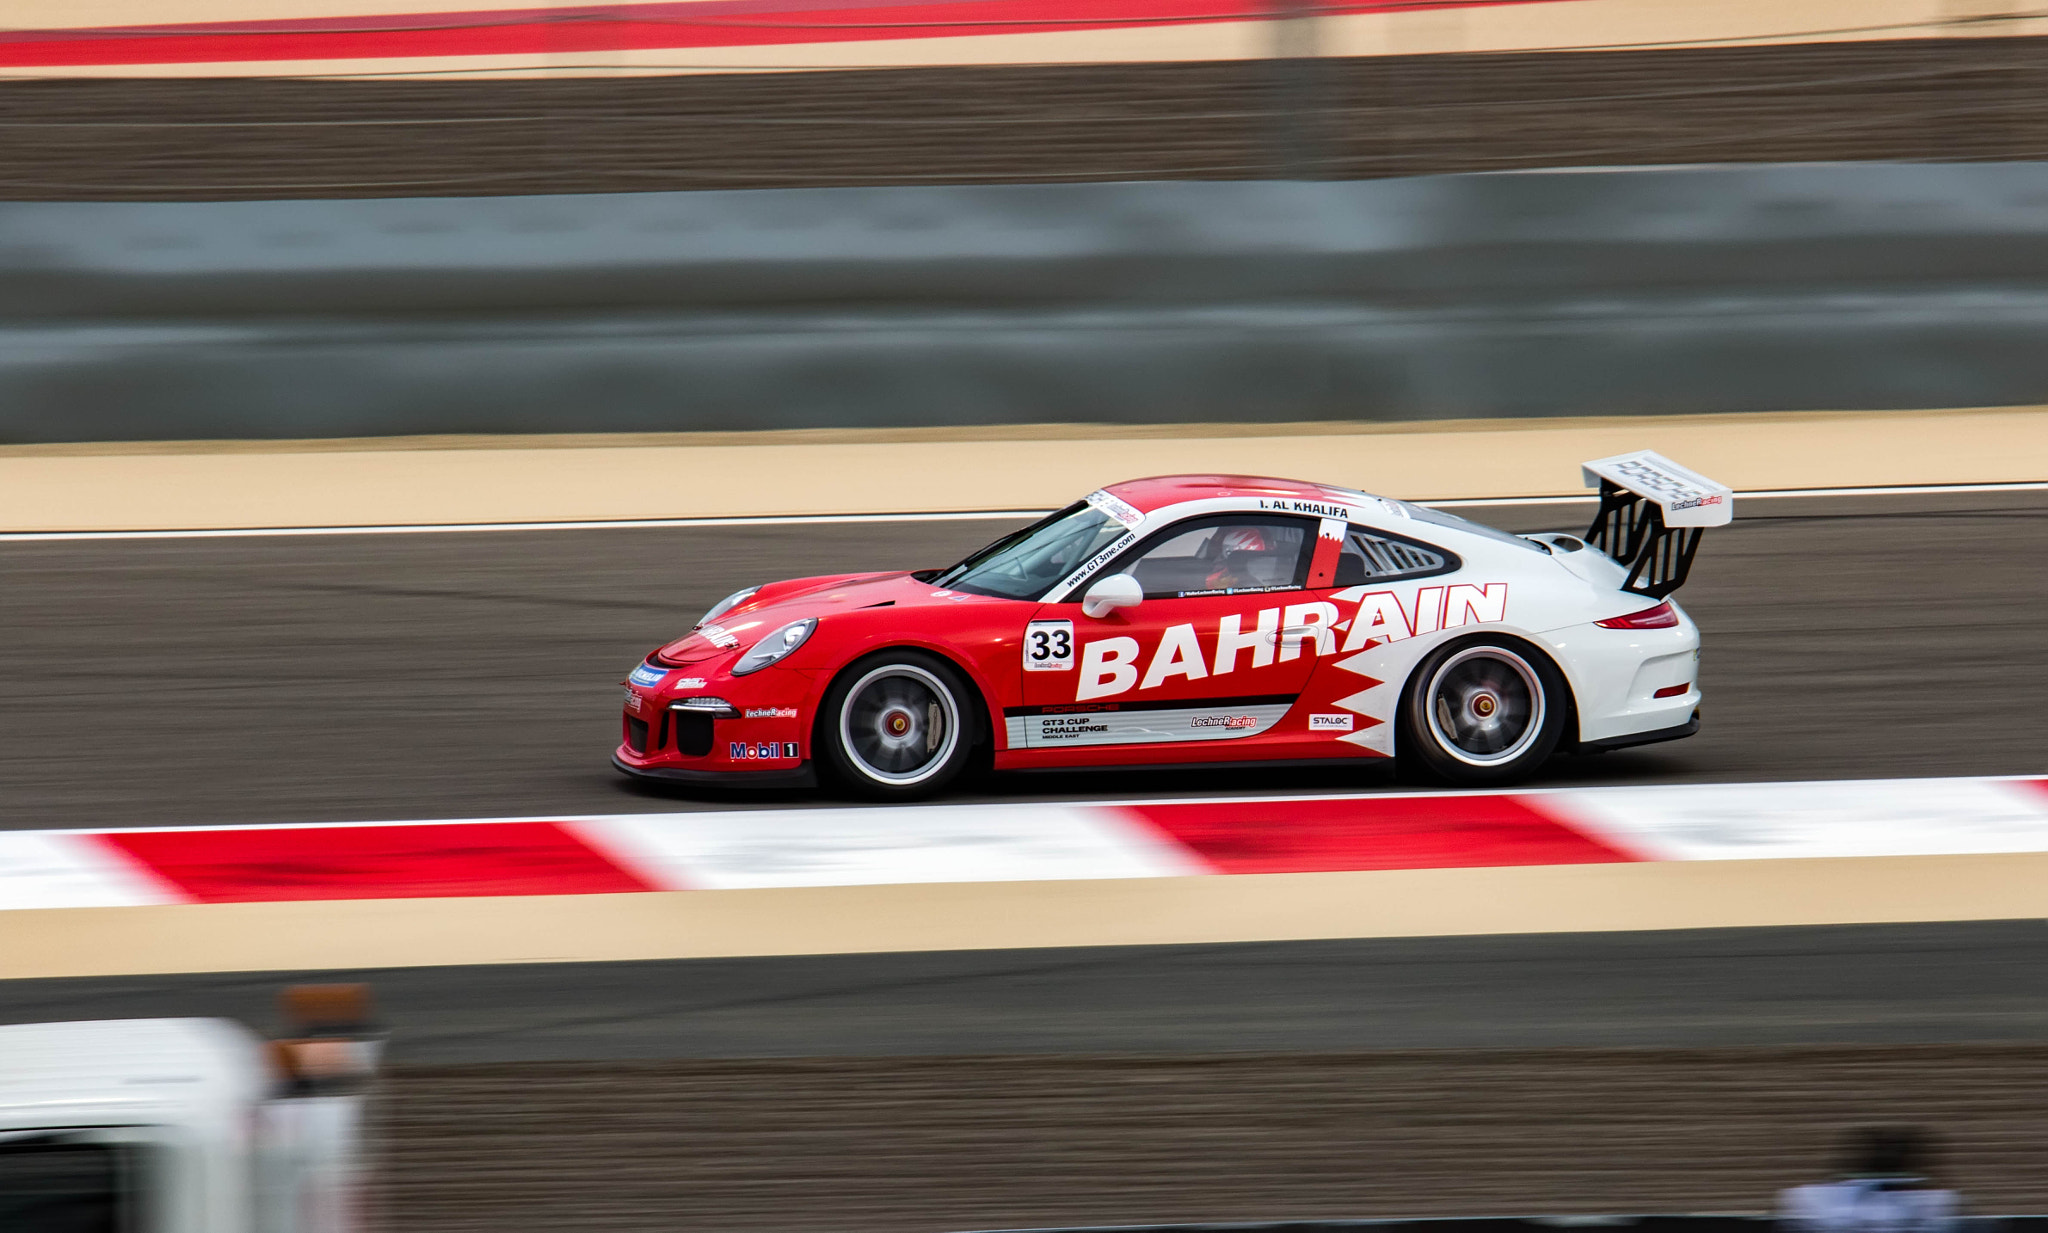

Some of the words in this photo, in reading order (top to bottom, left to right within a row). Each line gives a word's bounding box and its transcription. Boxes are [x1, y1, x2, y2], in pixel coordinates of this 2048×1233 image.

[1260, 500, 1268, 508] I.
[1273, 501, 1289, 509] AL
[1294, 502, 1348, 518] KHALIFA
[1067, 533, 1136, 587] www.GT3me.com
[1031, 629, 1071, 660] 33
[1075, 582, 1508, 702] BAHRAIN
[1042, 704, 1119, 713] PORSCHE
[1042, 725, 1108, 734] CHALLENGE
[730, 742, 779, 760] Mobil
